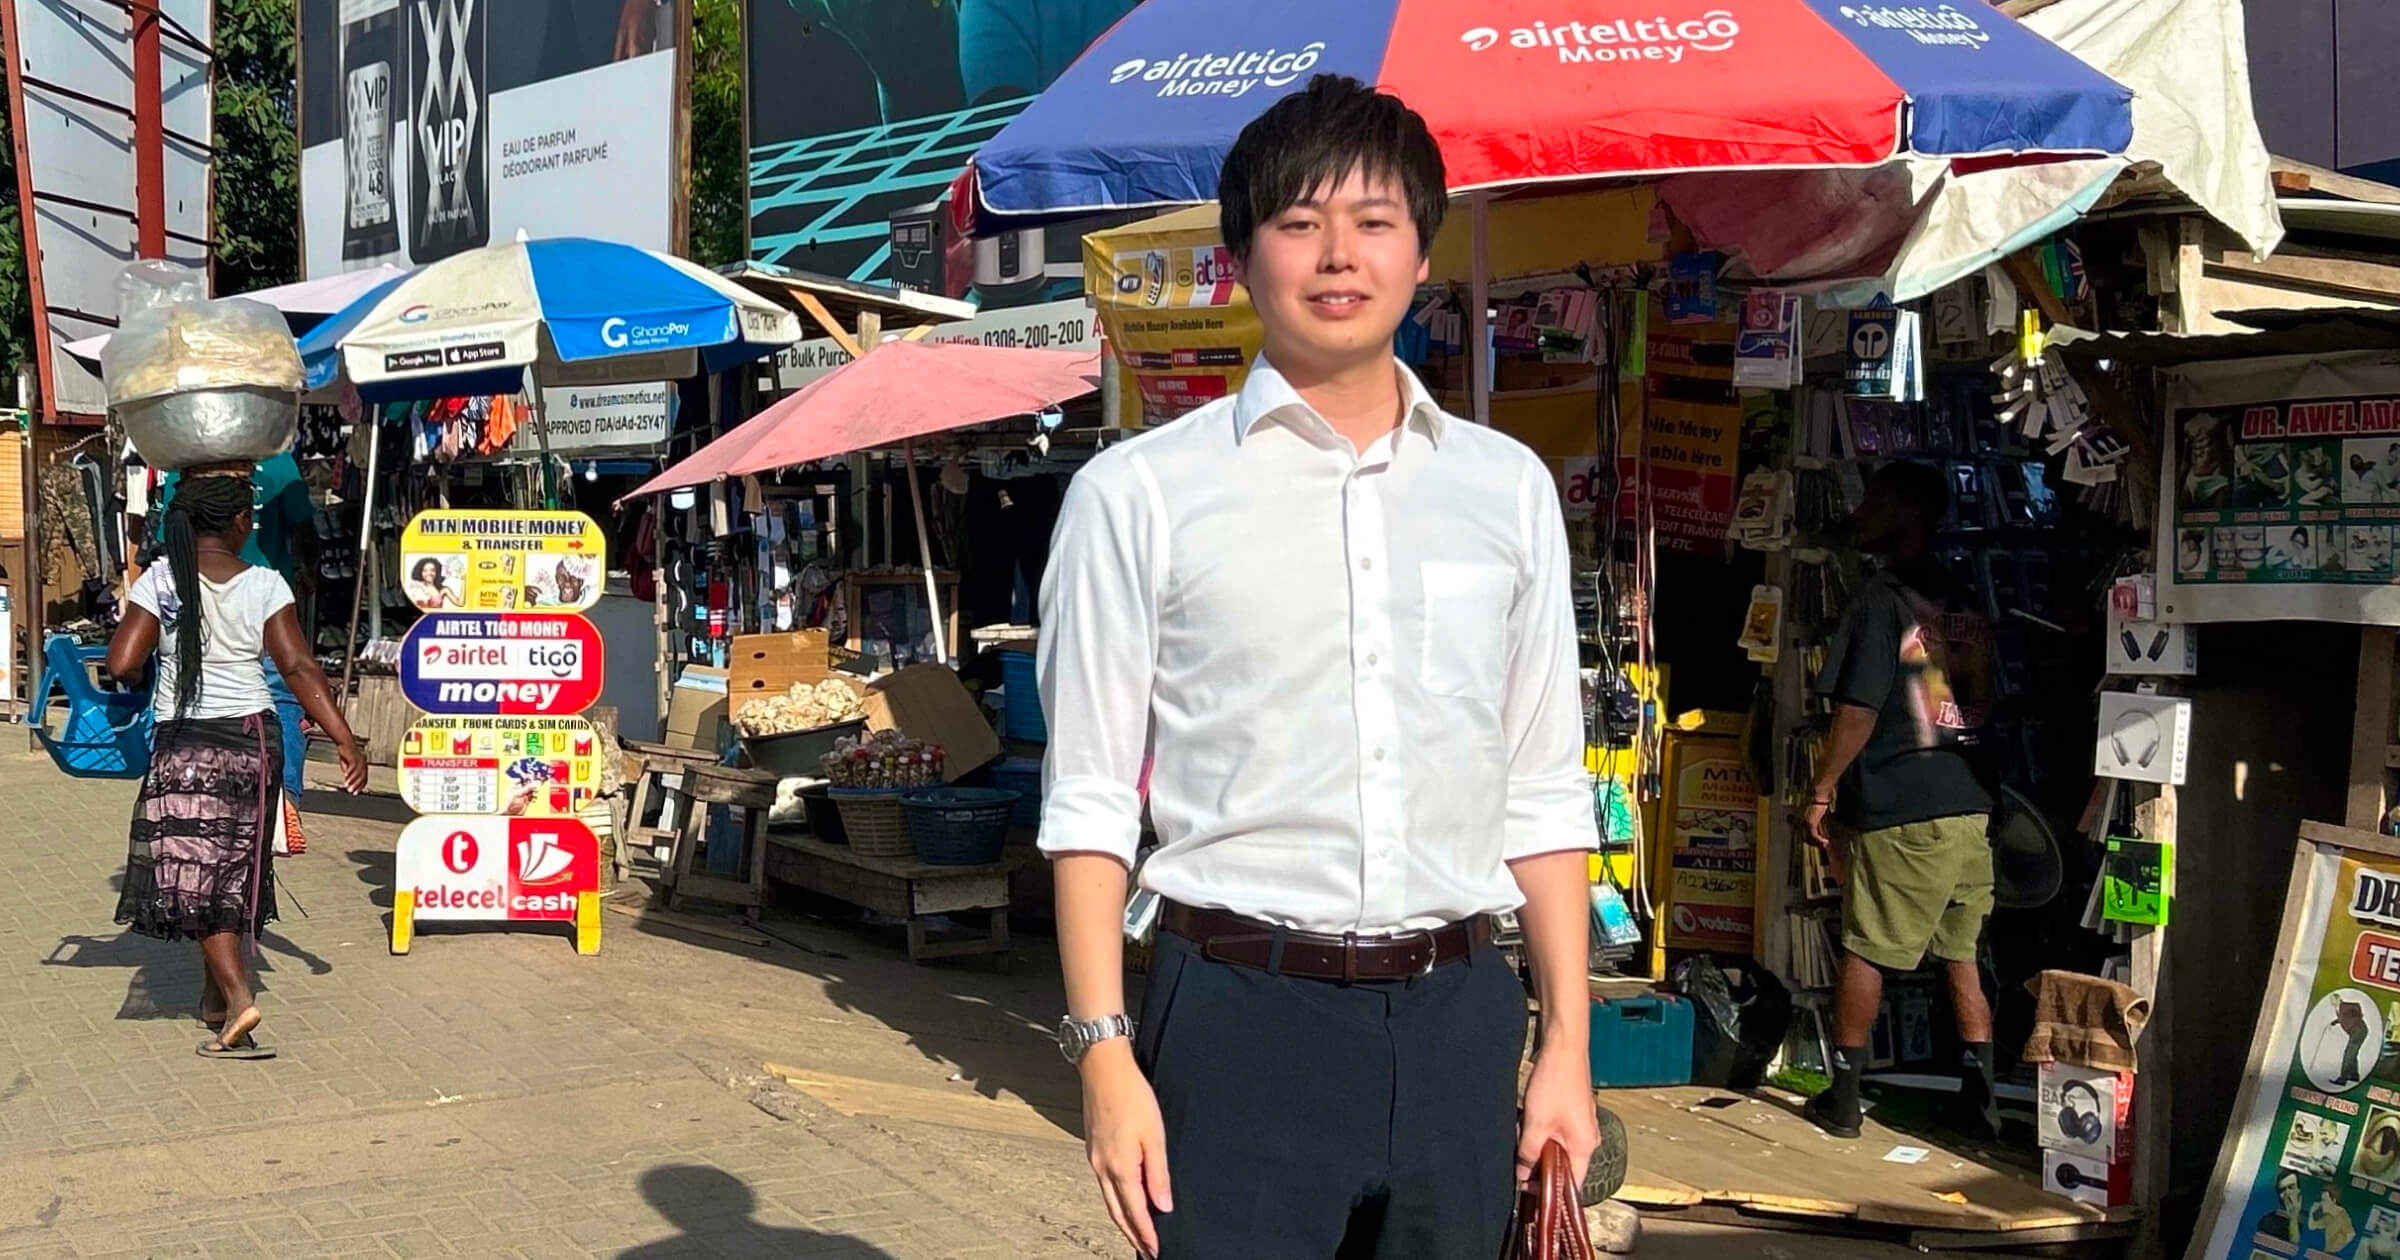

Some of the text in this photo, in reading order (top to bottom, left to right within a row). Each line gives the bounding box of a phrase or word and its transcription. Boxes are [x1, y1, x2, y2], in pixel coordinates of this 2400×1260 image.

[1559, 44, 1684, 63] Money
[364, 75, 388, 110] VIP
[1157, 78, 1258, 98] Money
[427, 118, 465, 167] VIP
[503, 128, 576, 158] EAU DE PARFUM
[503, 140, 608, 179] DÉODORANT PARFUMÉ
[368, 171, 384, 196] 48
[631, 321, 690, 339] GhanaPay
[399, 352, 440, 366] Google Play
[463, 346, 500, 361] App Store
[790, 345, 816, 368] Bulk
[2242, 406, 2285, 440] DR.
[2288, 401, 2359, 437] AWEL
[421, 519, 587, 536] MTN MOBILE MONEY
[462, 538, 543, 550] & TRANSFER
[436, 620, 568, 638] AIRTEL TIGO MONEY
[447, 644, 508, 665] airtel
[438, 680, 561, 710] money
[463, 718, 493, 729] PHONE
[495, 718, 527, 729] CARDS
[528, 719, 536, 729] &
[538, 719, 556, 730] SIM
[558, 719, 590, 730] CARDS
[422, 759, 479, 768] TRANSFER
[511, 891, 577, 911] cash
[2041, 1088, 2077, 1109] BAS
